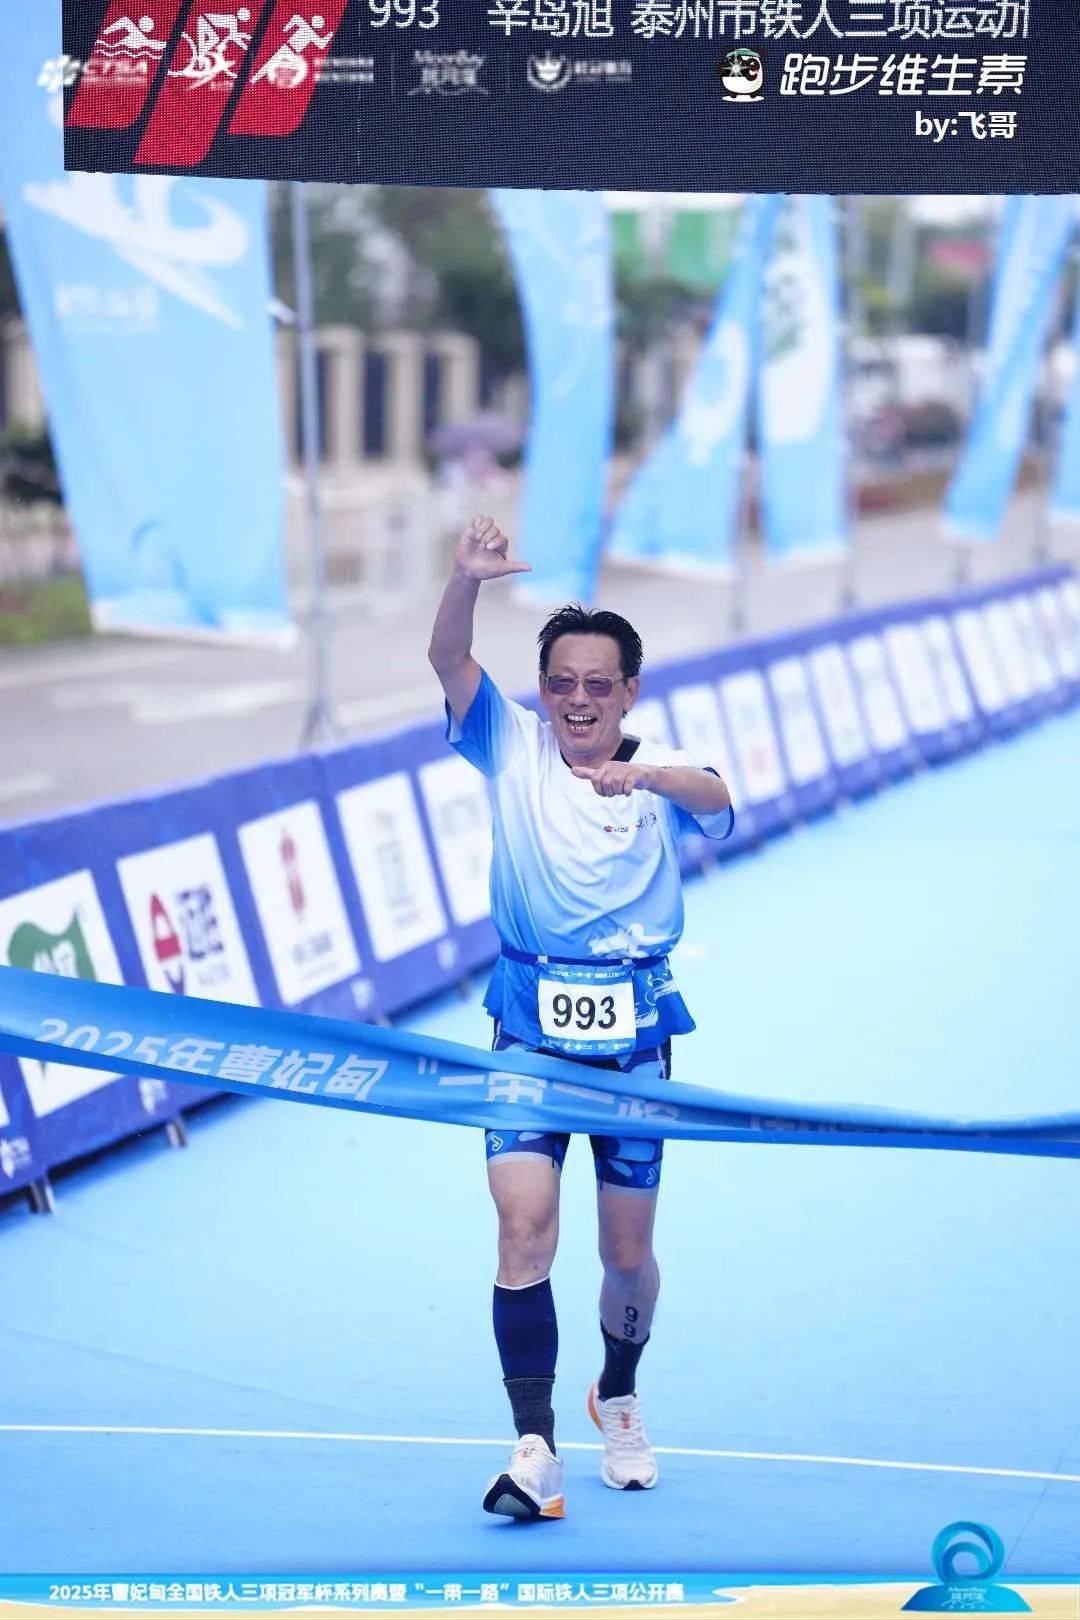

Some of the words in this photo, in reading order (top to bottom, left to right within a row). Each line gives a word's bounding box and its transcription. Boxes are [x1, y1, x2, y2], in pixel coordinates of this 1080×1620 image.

[369, 0, 440, 29] 993
[630, 0, 1030, 40] 泰州市铁人三项运动
[552, 993, 617, 1030] 993
[622, 1305, 639, 1344] 99
